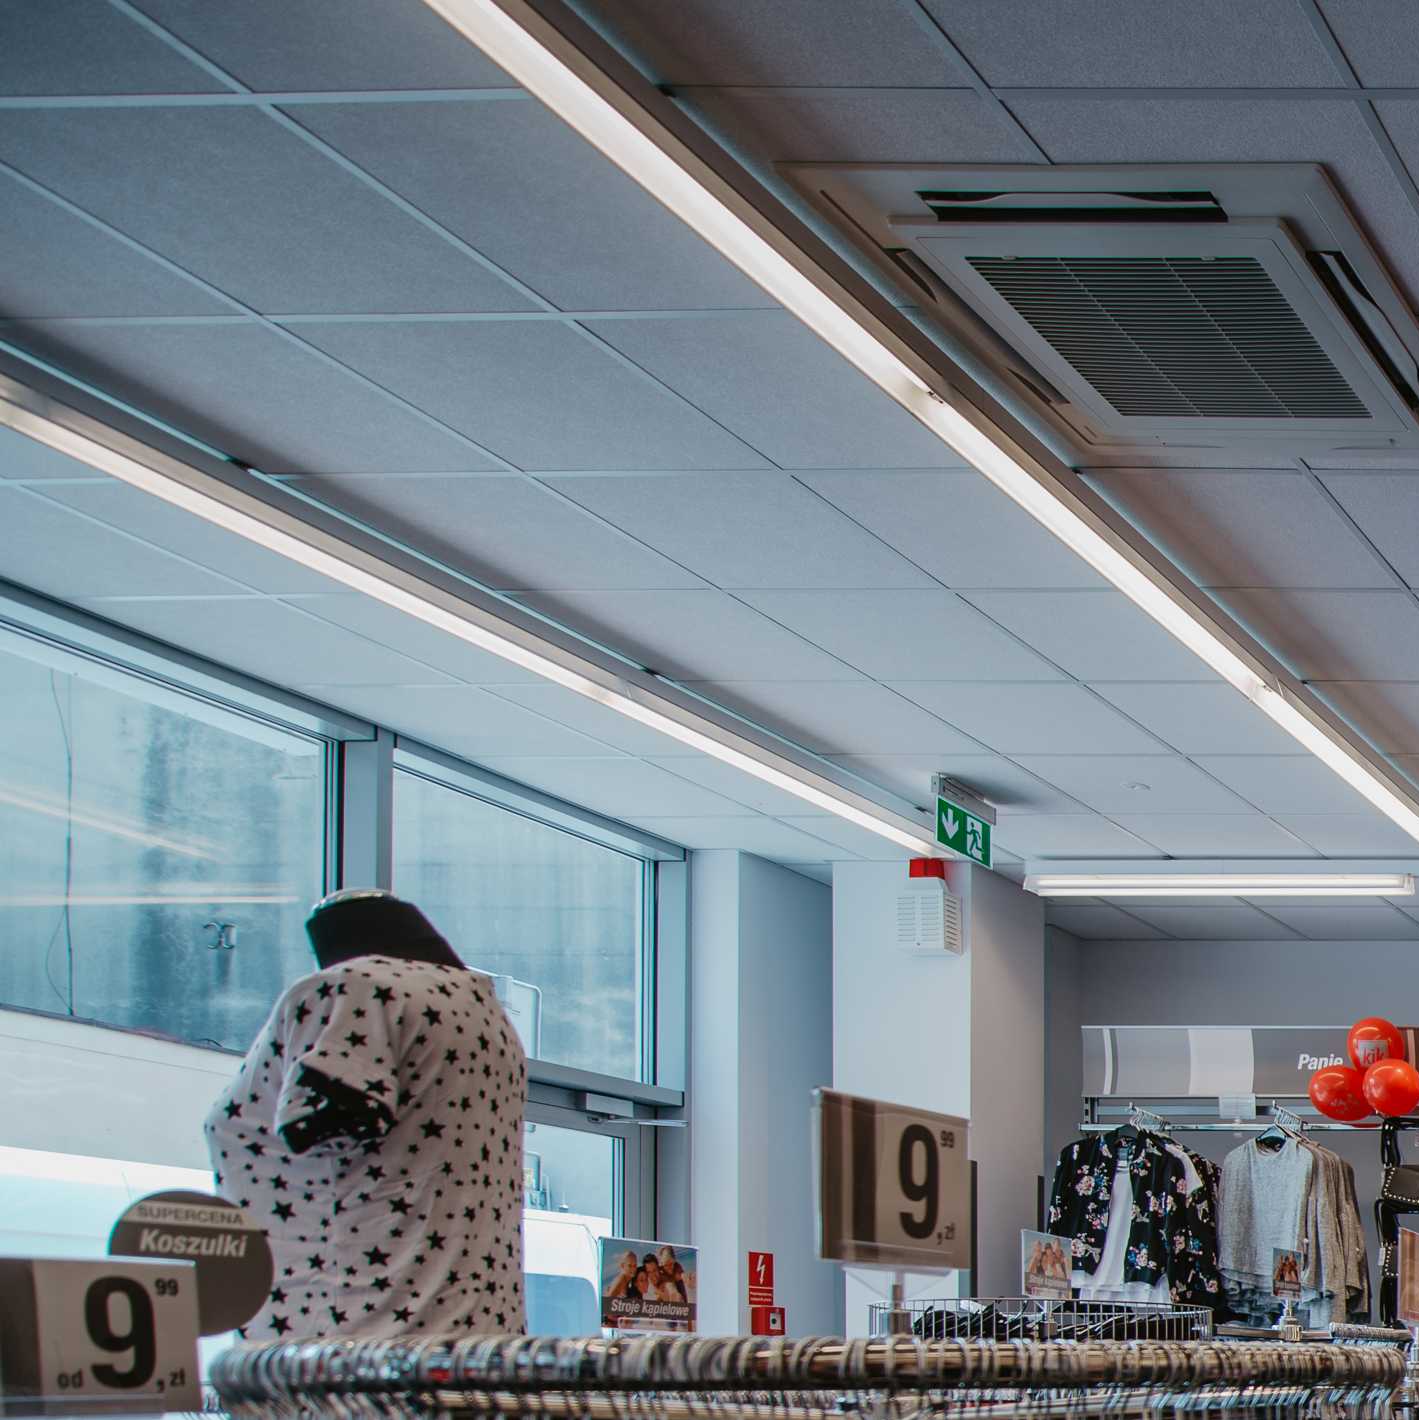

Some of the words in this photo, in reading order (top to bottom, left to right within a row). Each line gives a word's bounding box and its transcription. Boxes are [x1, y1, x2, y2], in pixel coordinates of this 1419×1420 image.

[1297, 1053, 1344, 1070] Panie
[137, 1204, 244, 1226] SUPERCENA
[139, 1228, 249, 1258] Koszulki
[611, 1299, 641, 1315] Stroje
[642, 1301, 690, 1318] kąpielowe
[57, 1369, 84, 1389] od
[155, 1278, 179, 1296] 99
